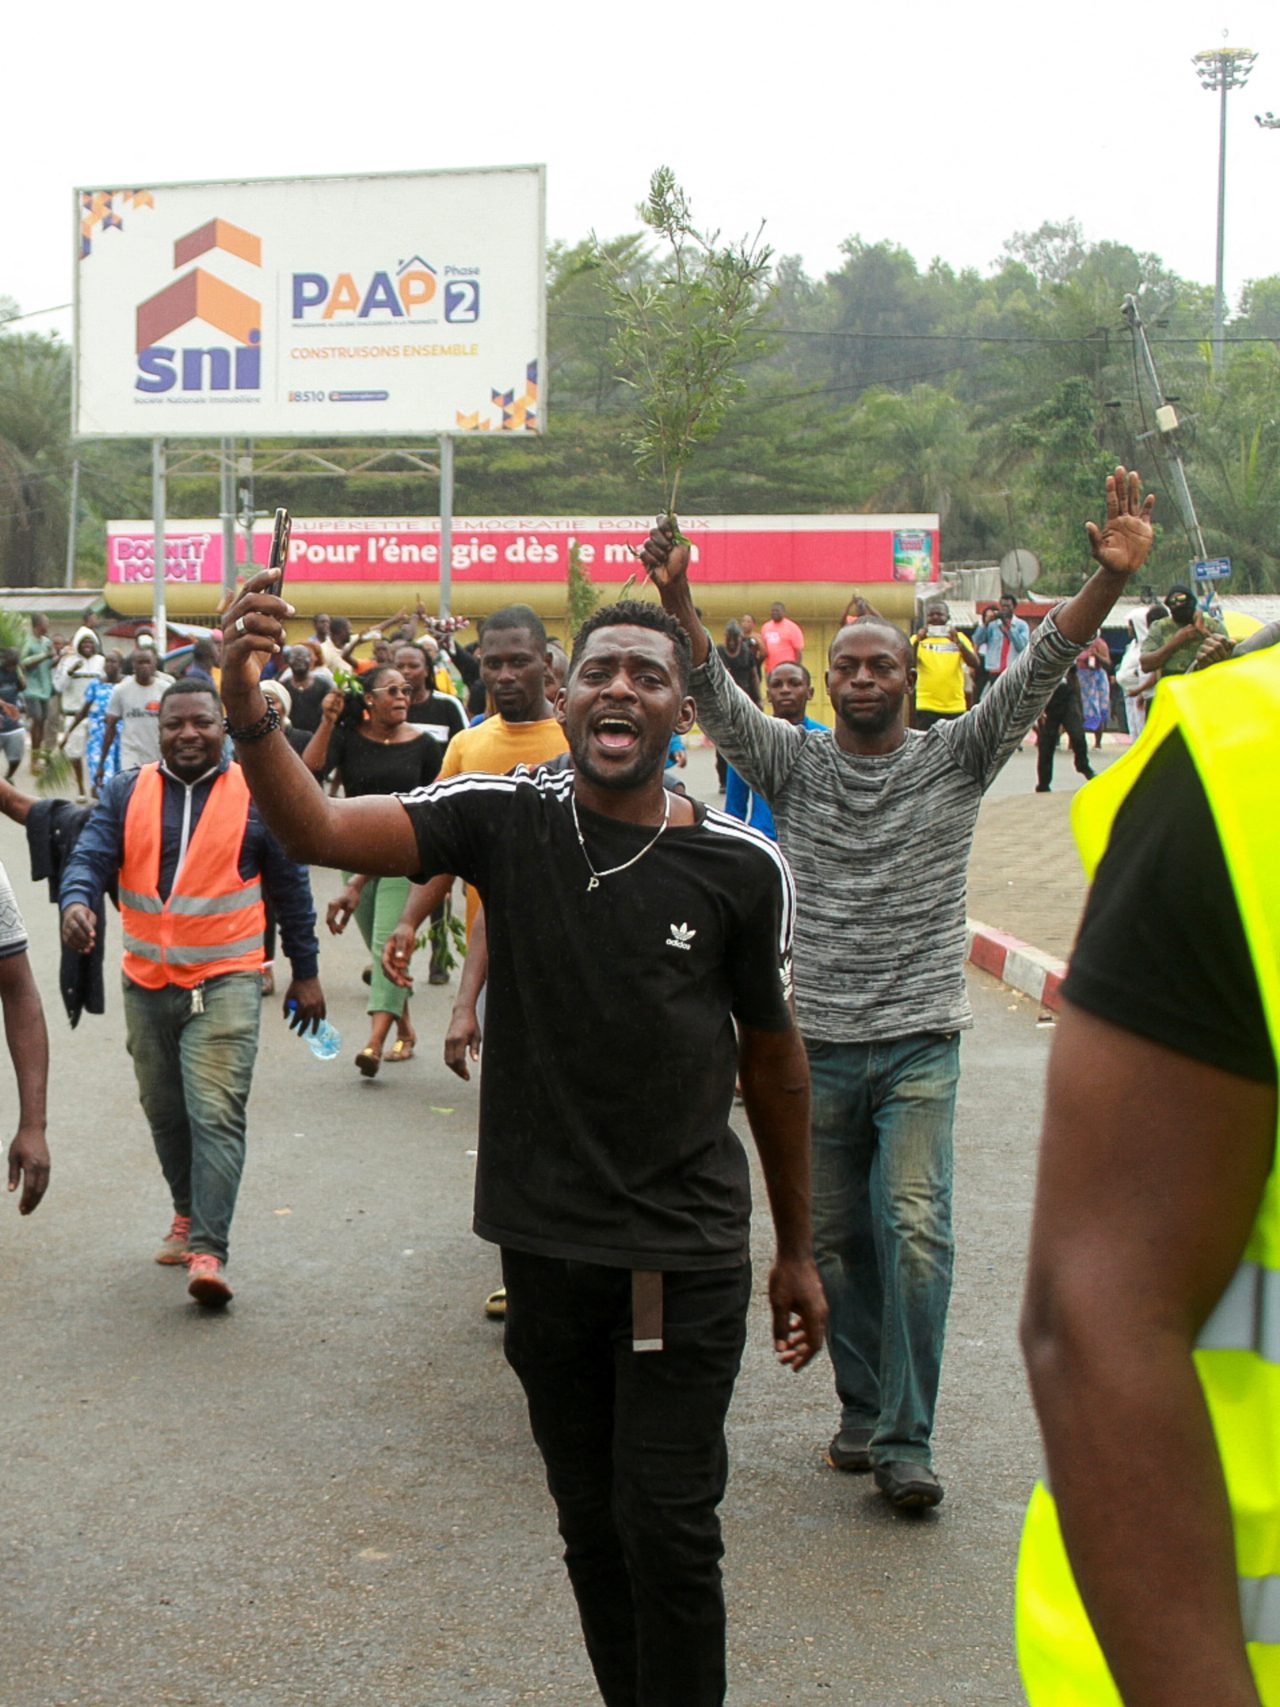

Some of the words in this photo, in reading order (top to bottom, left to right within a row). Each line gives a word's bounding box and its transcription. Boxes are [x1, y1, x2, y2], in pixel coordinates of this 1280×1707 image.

[444, 265, 480, 277] Phase
[292, 270, 437, 319] PAAP
[448, 282, 477, 321] 2
[134, 327, 261, 393] sni
[290, 345, 400, 359] CONSTRUISONS
[403, 343, 479, 357] ENSEMBLE
[295, 391, 325, 402] 8510
[288, 538, 361, 563] Pour
[368, 536, 498, 570] l'énegie
[505, 535, 559, 563] dès
[665, 938, 691, 951] adidas
